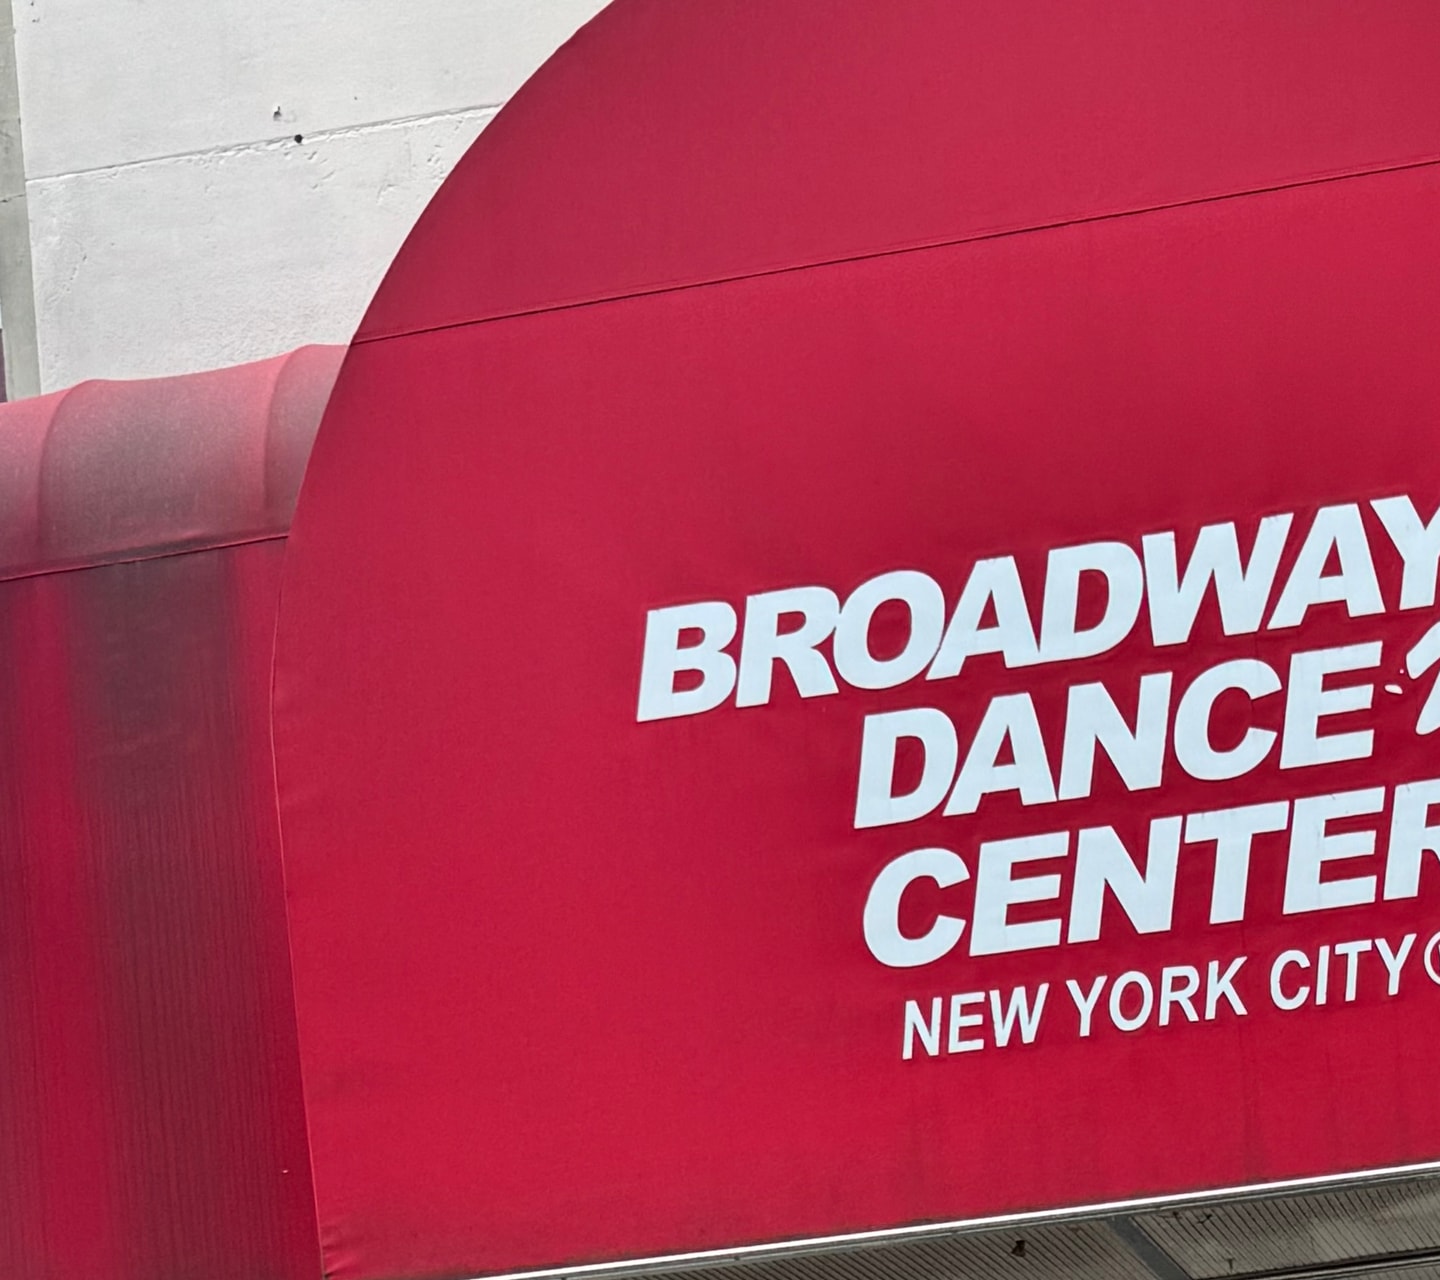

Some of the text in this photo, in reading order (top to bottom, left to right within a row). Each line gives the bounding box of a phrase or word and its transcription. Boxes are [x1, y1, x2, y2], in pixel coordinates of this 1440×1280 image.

[854, 641, 1382, 828] DANCE
[903, 983, 1049, 1059] NEW
[1066, 957, 1247, 1036] YORK
